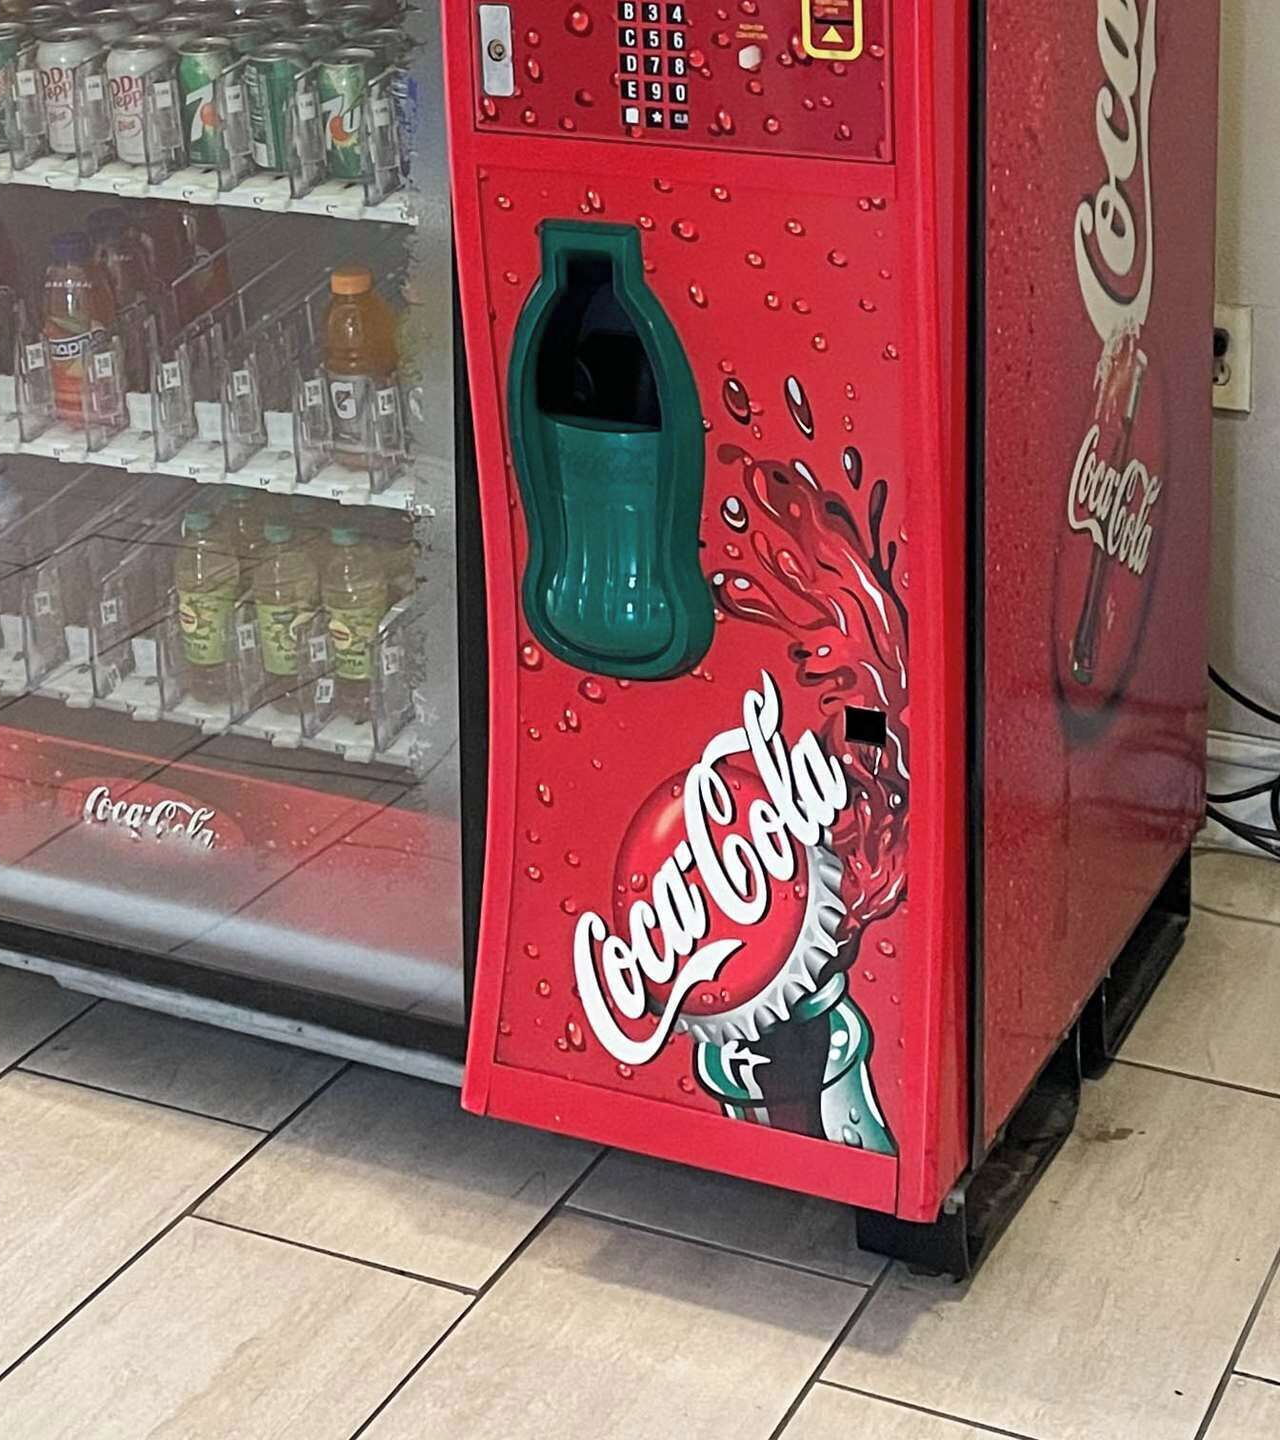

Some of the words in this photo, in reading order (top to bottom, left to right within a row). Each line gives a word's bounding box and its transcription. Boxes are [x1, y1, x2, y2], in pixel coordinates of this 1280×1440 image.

[624, 3, 634, 20] B
[648, 4, 658, 21] 3
[672, 5, 682, 23] 4
[625, 29, 635, 46] C
[649, 30, 659, 47] 5
[673, 31, 683, 49] 6
[626, 55, 637, 72] D
[650, 56, 660, 73] 7
[674, 58, 684, 75] 8
[627, 81, 637, 98] E
[651, 82, 661, 100] 9
[675, 84, 685, 101] 0
[1068, 424, 1162, 575] Coca-Cola
[574, 668, 848, 1065] Coca-Cola
